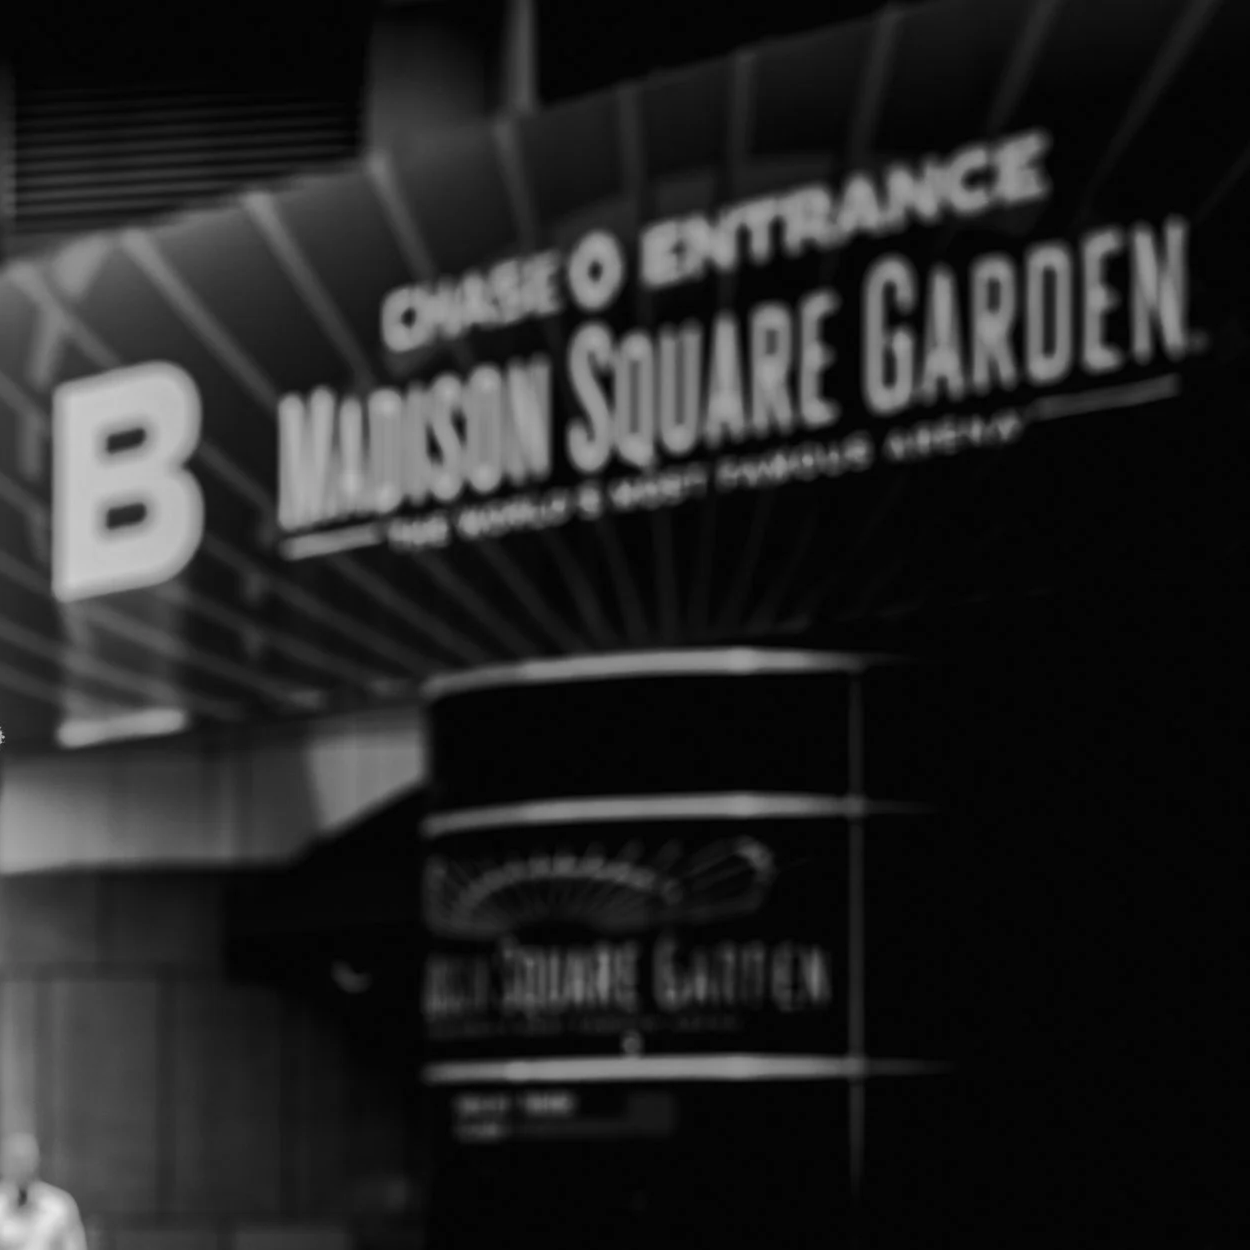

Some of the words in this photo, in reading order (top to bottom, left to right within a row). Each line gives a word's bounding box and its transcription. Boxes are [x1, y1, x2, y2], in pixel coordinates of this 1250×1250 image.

[381, 256, 560, 351] CHASE
[641, 134, 1049, 288] ENTRANCE
[52, 361, 204, 601] B
[278, 358, 550, 530] MADISON
[568, 292, 838, 473] SQUARE
[863, 217, 1188, 413] GARDEN
